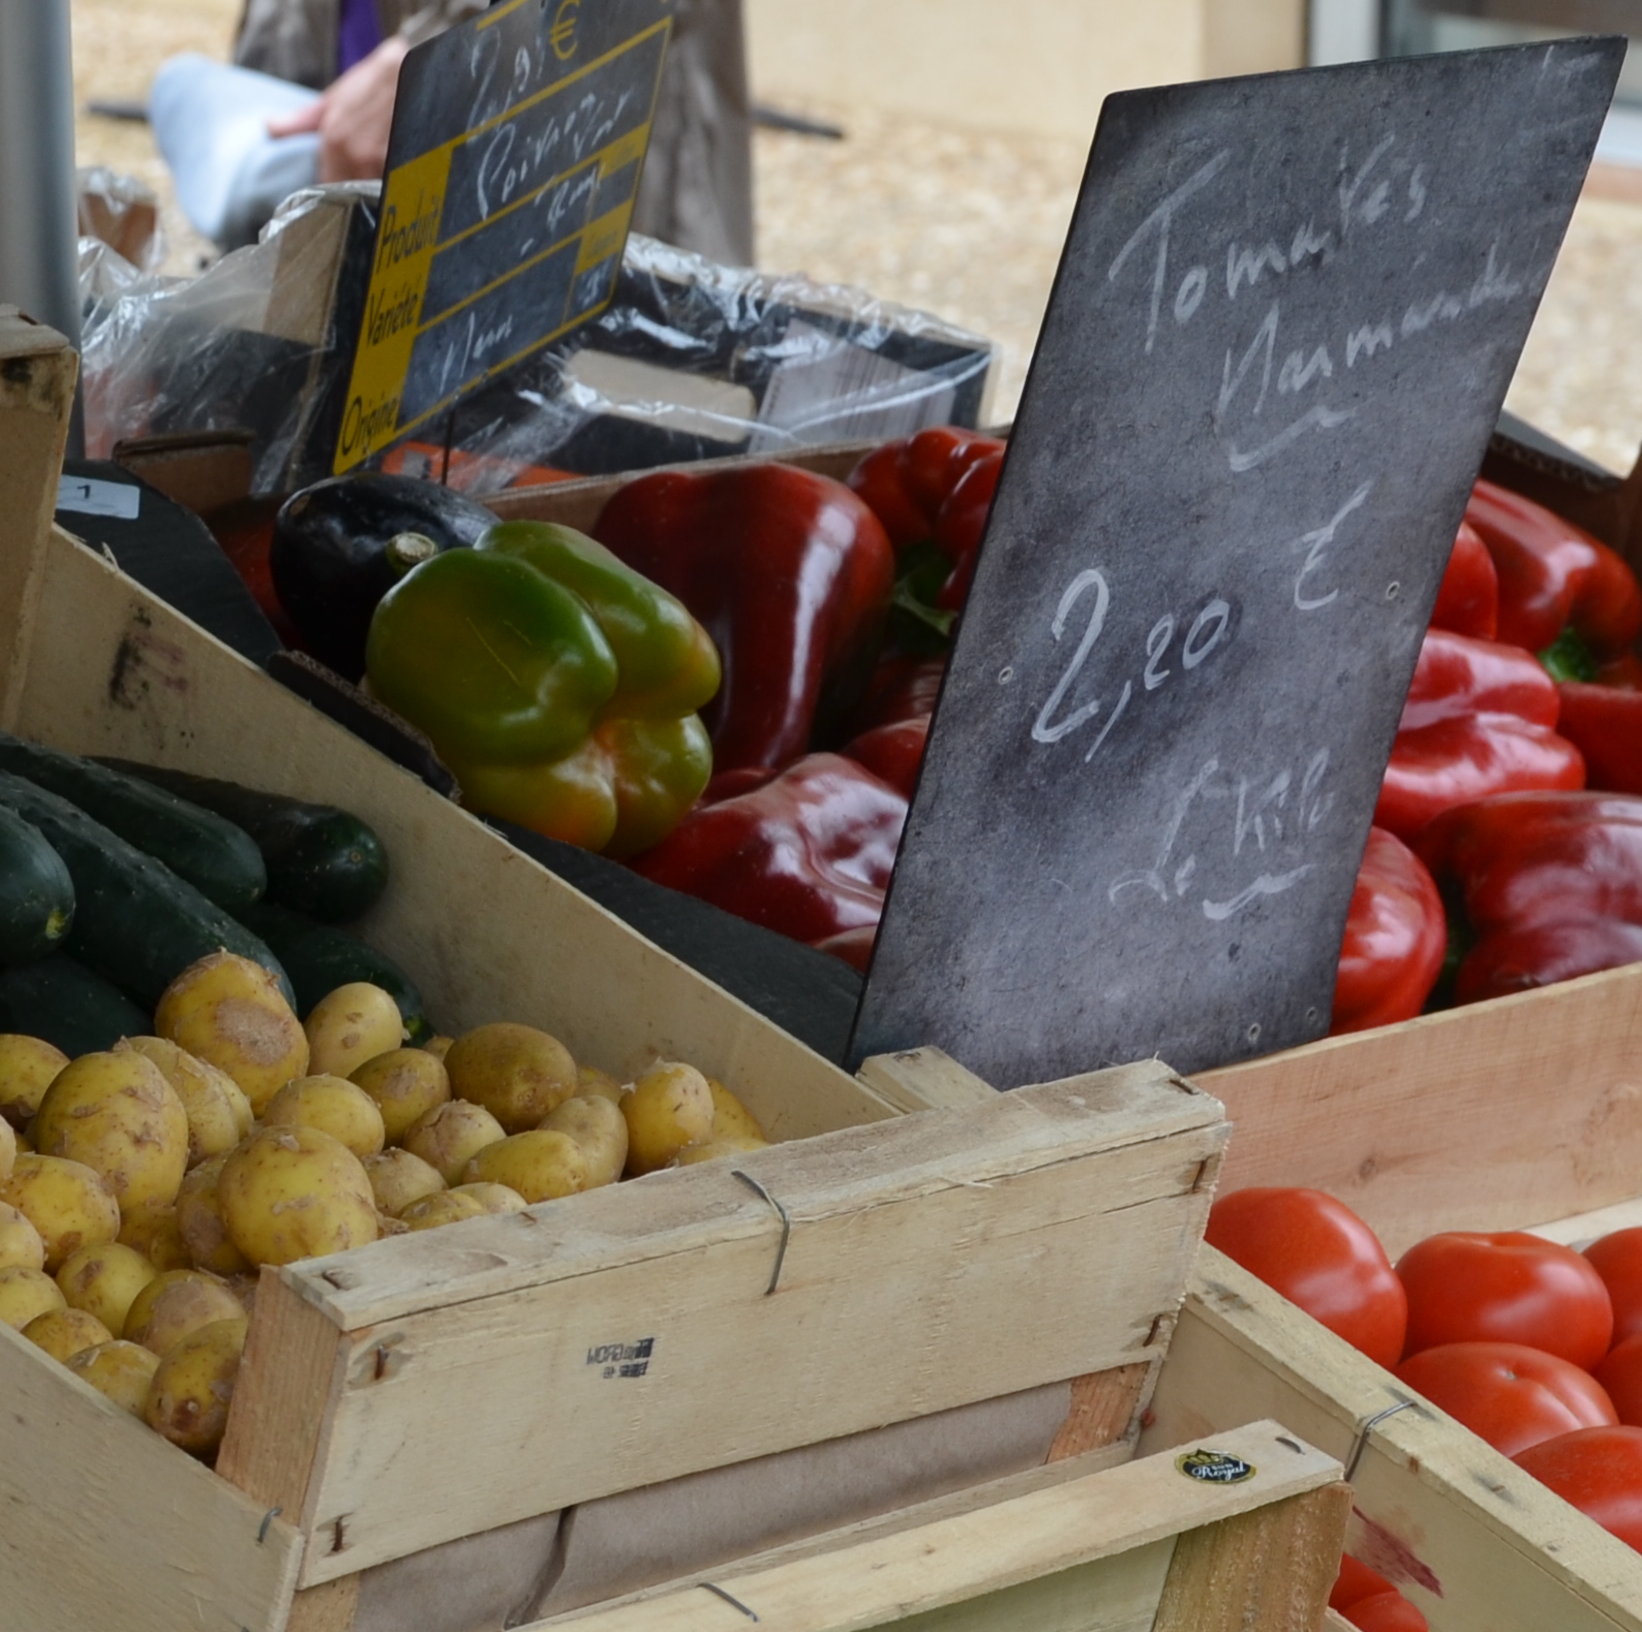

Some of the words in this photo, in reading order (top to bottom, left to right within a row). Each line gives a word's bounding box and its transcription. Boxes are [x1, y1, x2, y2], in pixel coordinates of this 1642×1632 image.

[376, 187, 441, 274] Produit
[1108, 130, 1427, 356] Tomates
[341, 390, 399, 457] Origine
[1030, 566, 1233, 764] 2,20
[1191, 1460, 1248, 1481] Royal
